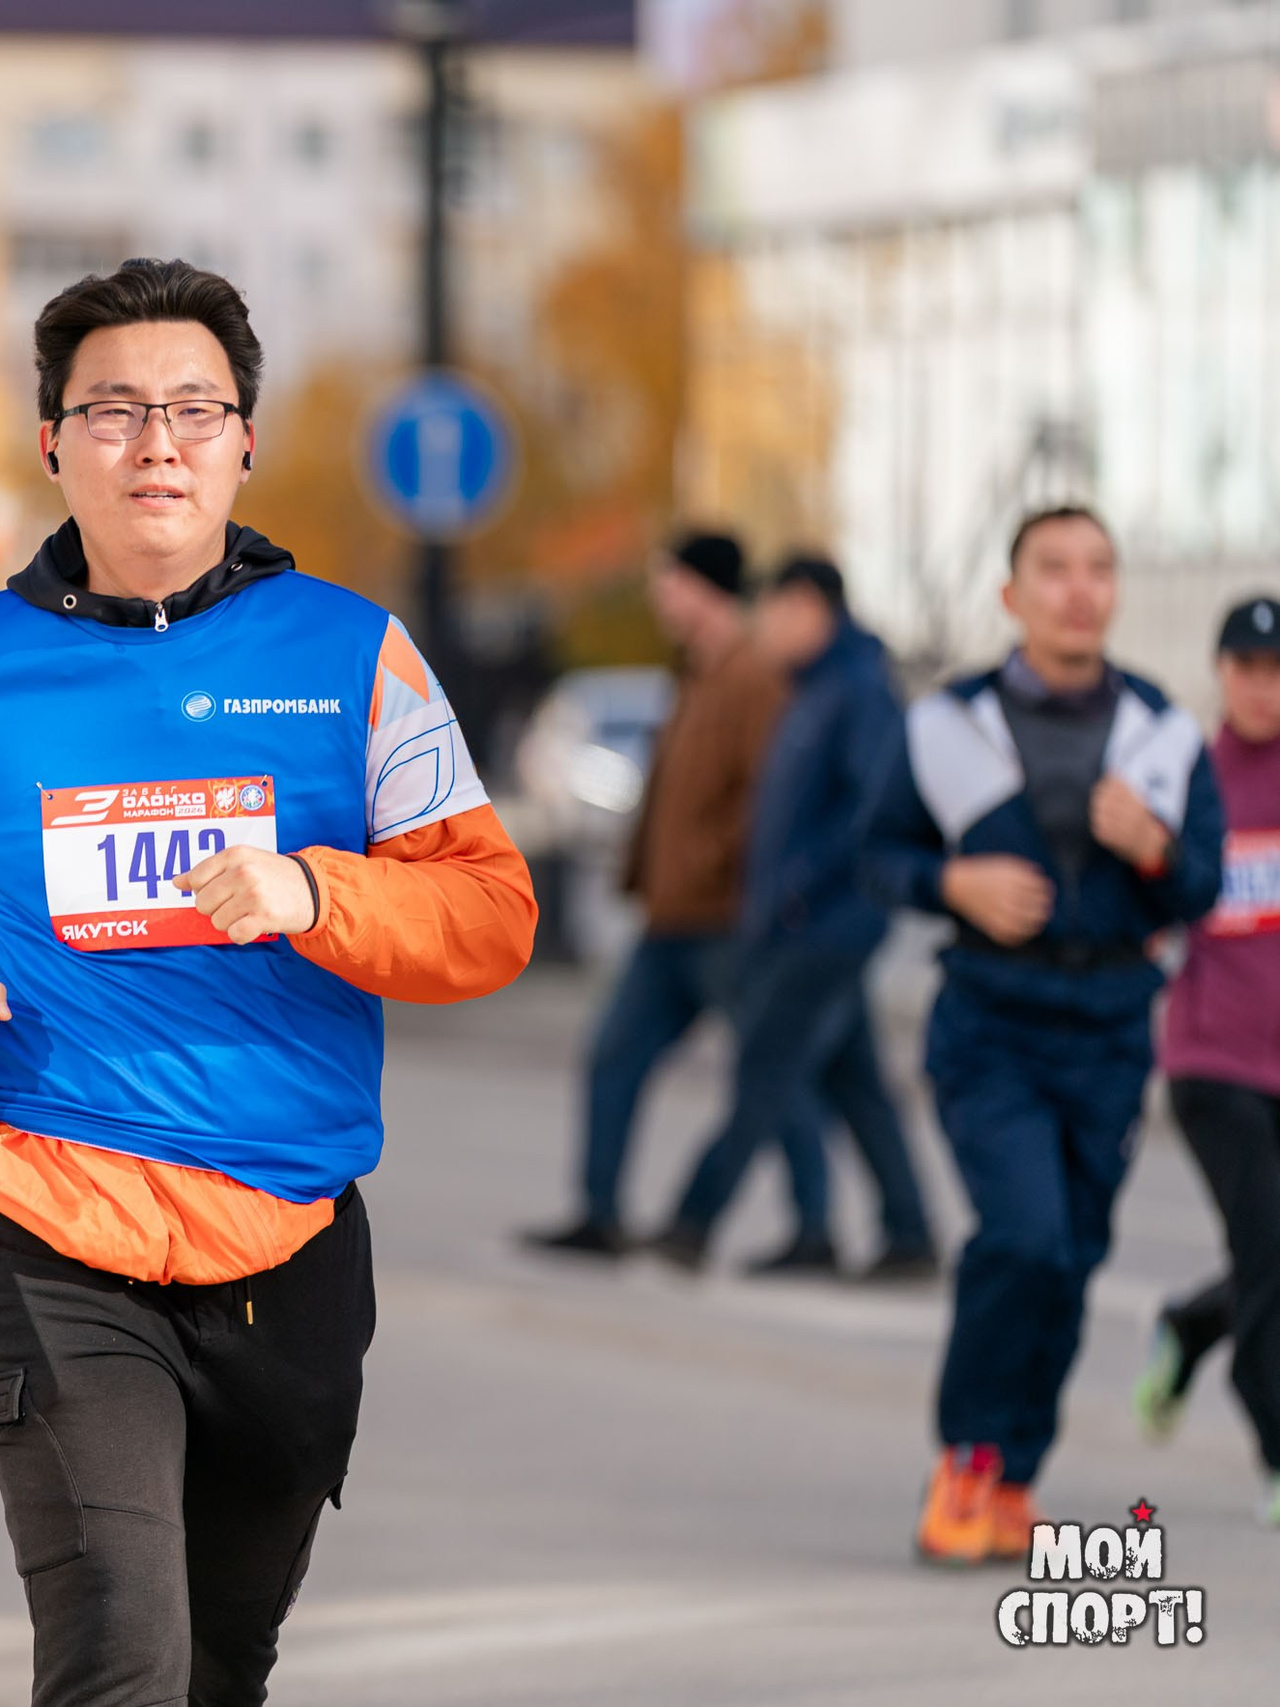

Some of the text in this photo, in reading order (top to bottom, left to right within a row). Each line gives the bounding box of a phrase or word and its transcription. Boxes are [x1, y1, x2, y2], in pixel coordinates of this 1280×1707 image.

[224, 699, 341, 714] ГАЗПРОМБАНК
[122, 793, 206, 808] ОЛОНХО
[123, 807, 174, 818] МАРАФОН
[61, 920, 148, 941] ЯКУТСК
